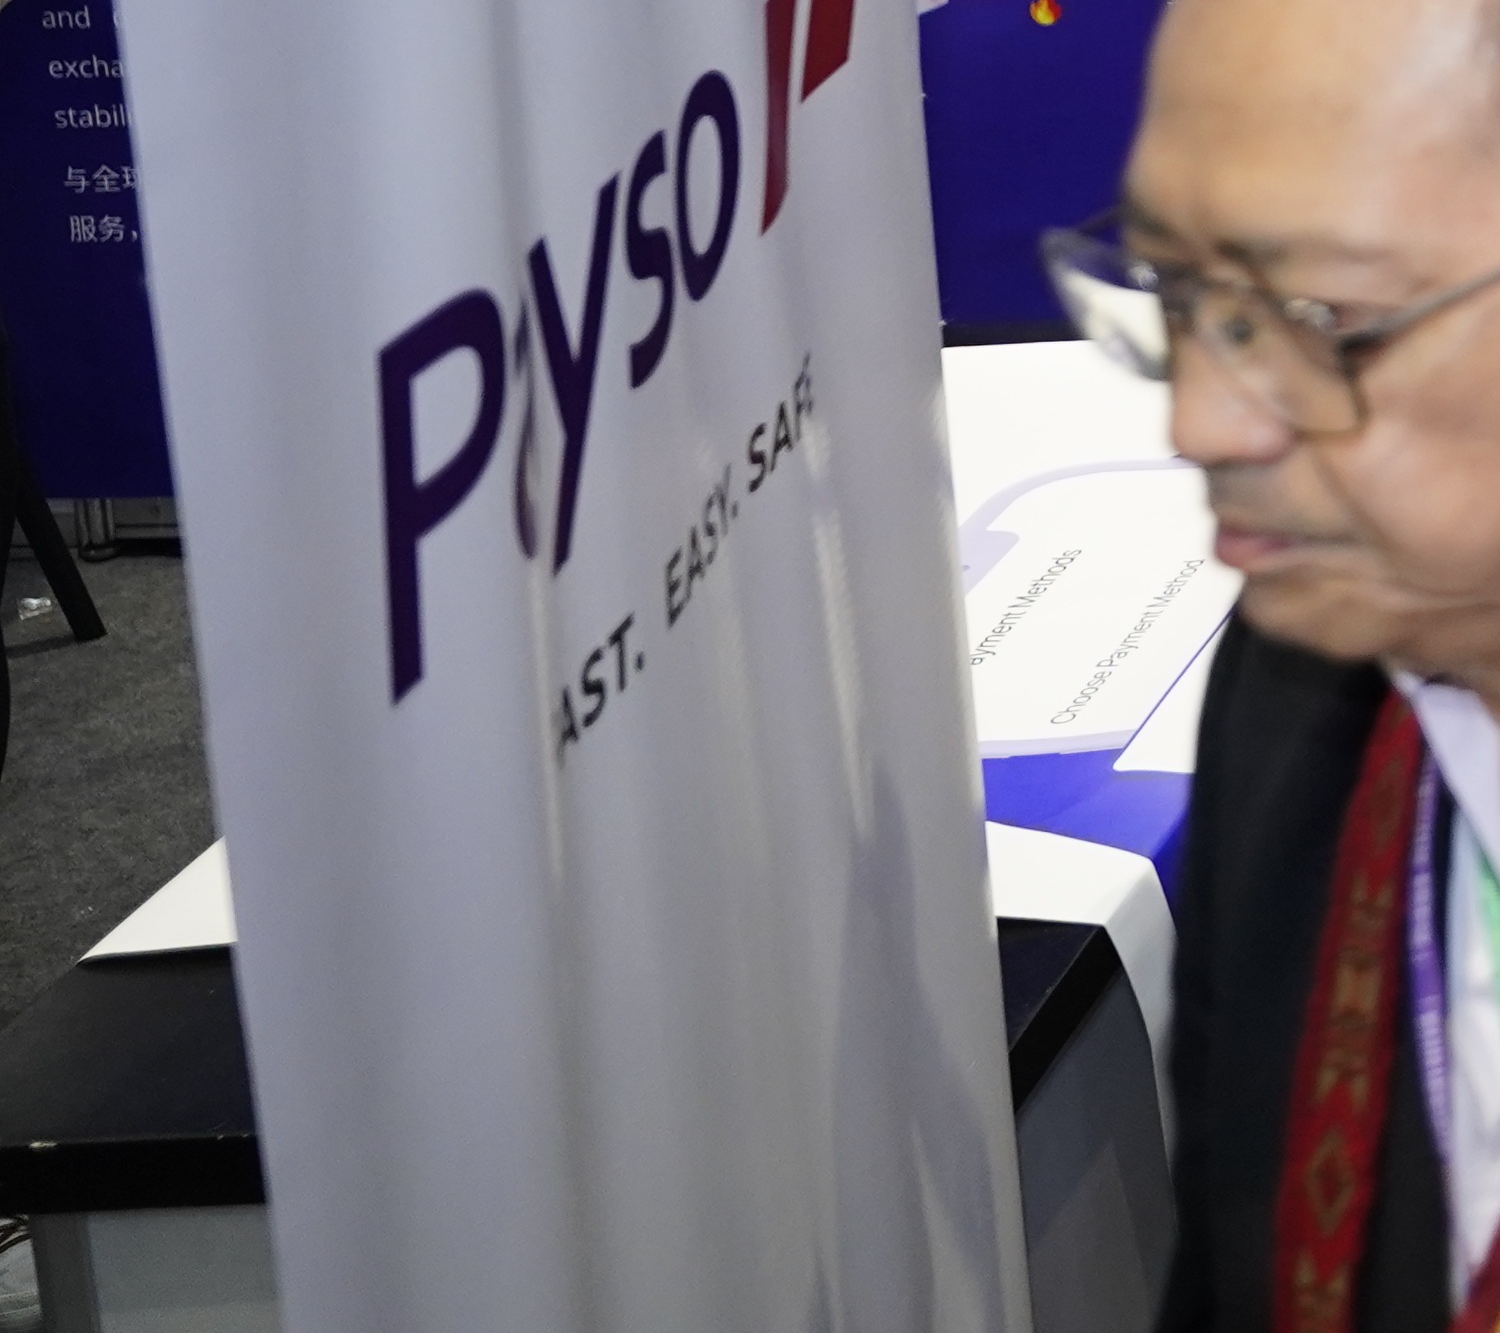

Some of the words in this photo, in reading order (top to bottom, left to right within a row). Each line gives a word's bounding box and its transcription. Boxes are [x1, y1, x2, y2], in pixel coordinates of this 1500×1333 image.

[42, 5, 91, 29] and
[1008, 549, 1082, 608] Methods
[1050, 670, 1112, 724] Choose
[1096, 610, 1164, 668] Payment
[1146, 558, 1206, 608] Method
